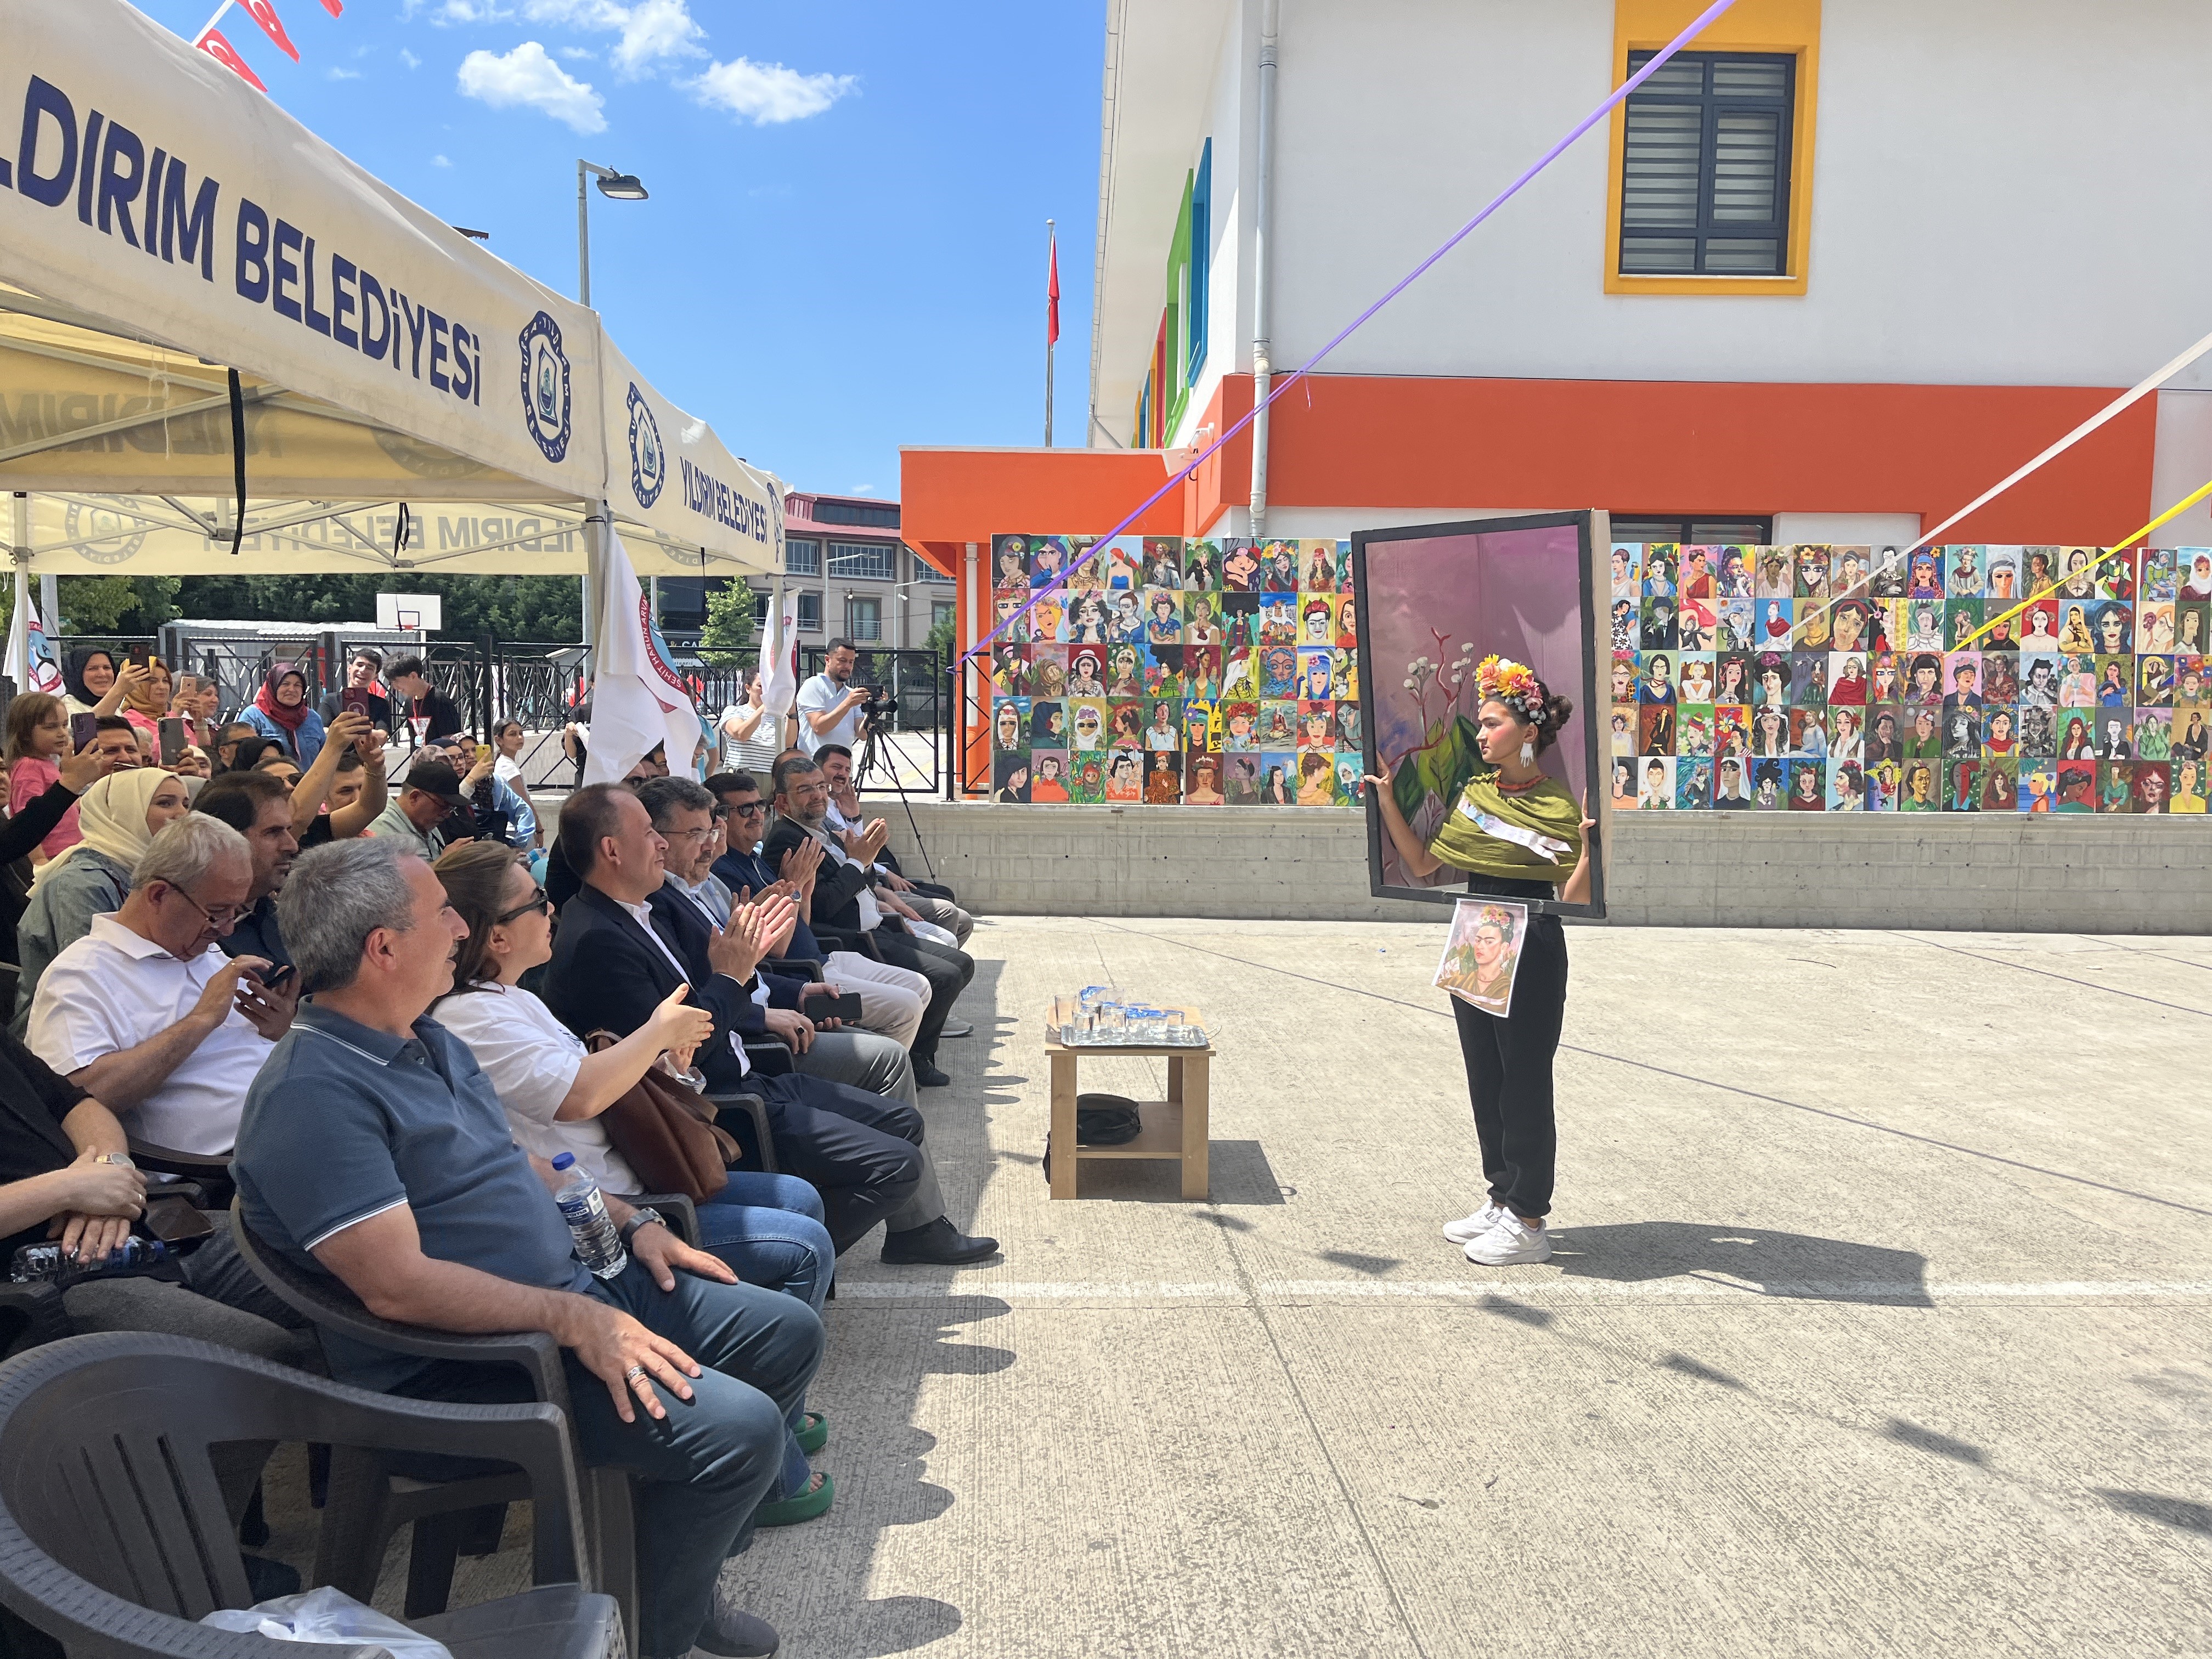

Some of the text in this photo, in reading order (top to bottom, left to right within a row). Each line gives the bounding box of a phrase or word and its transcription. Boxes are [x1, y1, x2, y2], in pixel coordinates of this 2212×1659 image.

[235, 198, 481, 407] BELEDİYESİ
[715, 479, 768, 545] BELEDİYESİ
[640, 595, 649, 625] ARVA
[642, 627, 659, 665] HARUN
